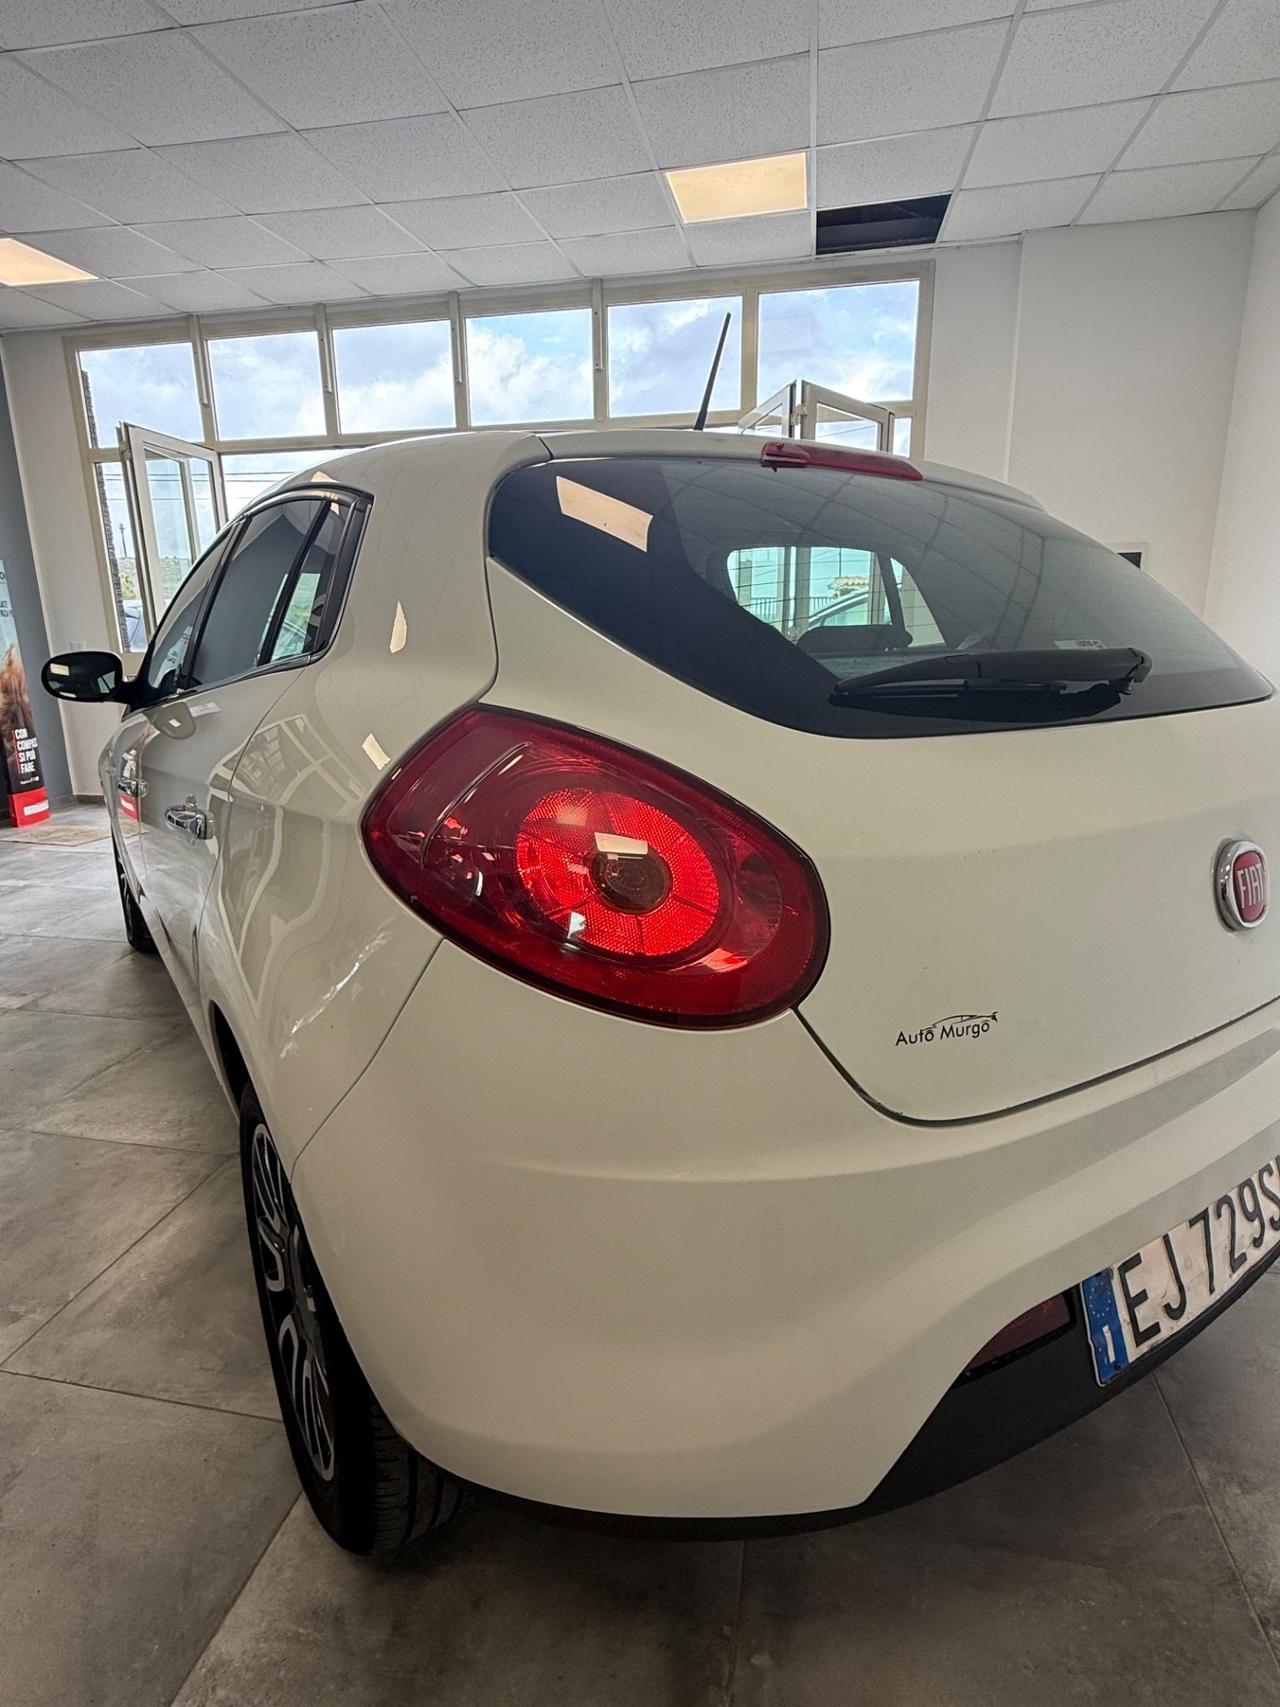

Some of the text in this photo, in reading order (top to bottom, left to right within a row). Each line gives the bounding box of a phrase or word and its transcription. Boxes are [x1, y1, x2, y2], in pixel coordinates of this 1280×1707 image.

[20, 762, 35, 774] FARE
[1237, 863, 1264, 909] FIAT
[895, 1022, 990, 1046] Auto Murgo
